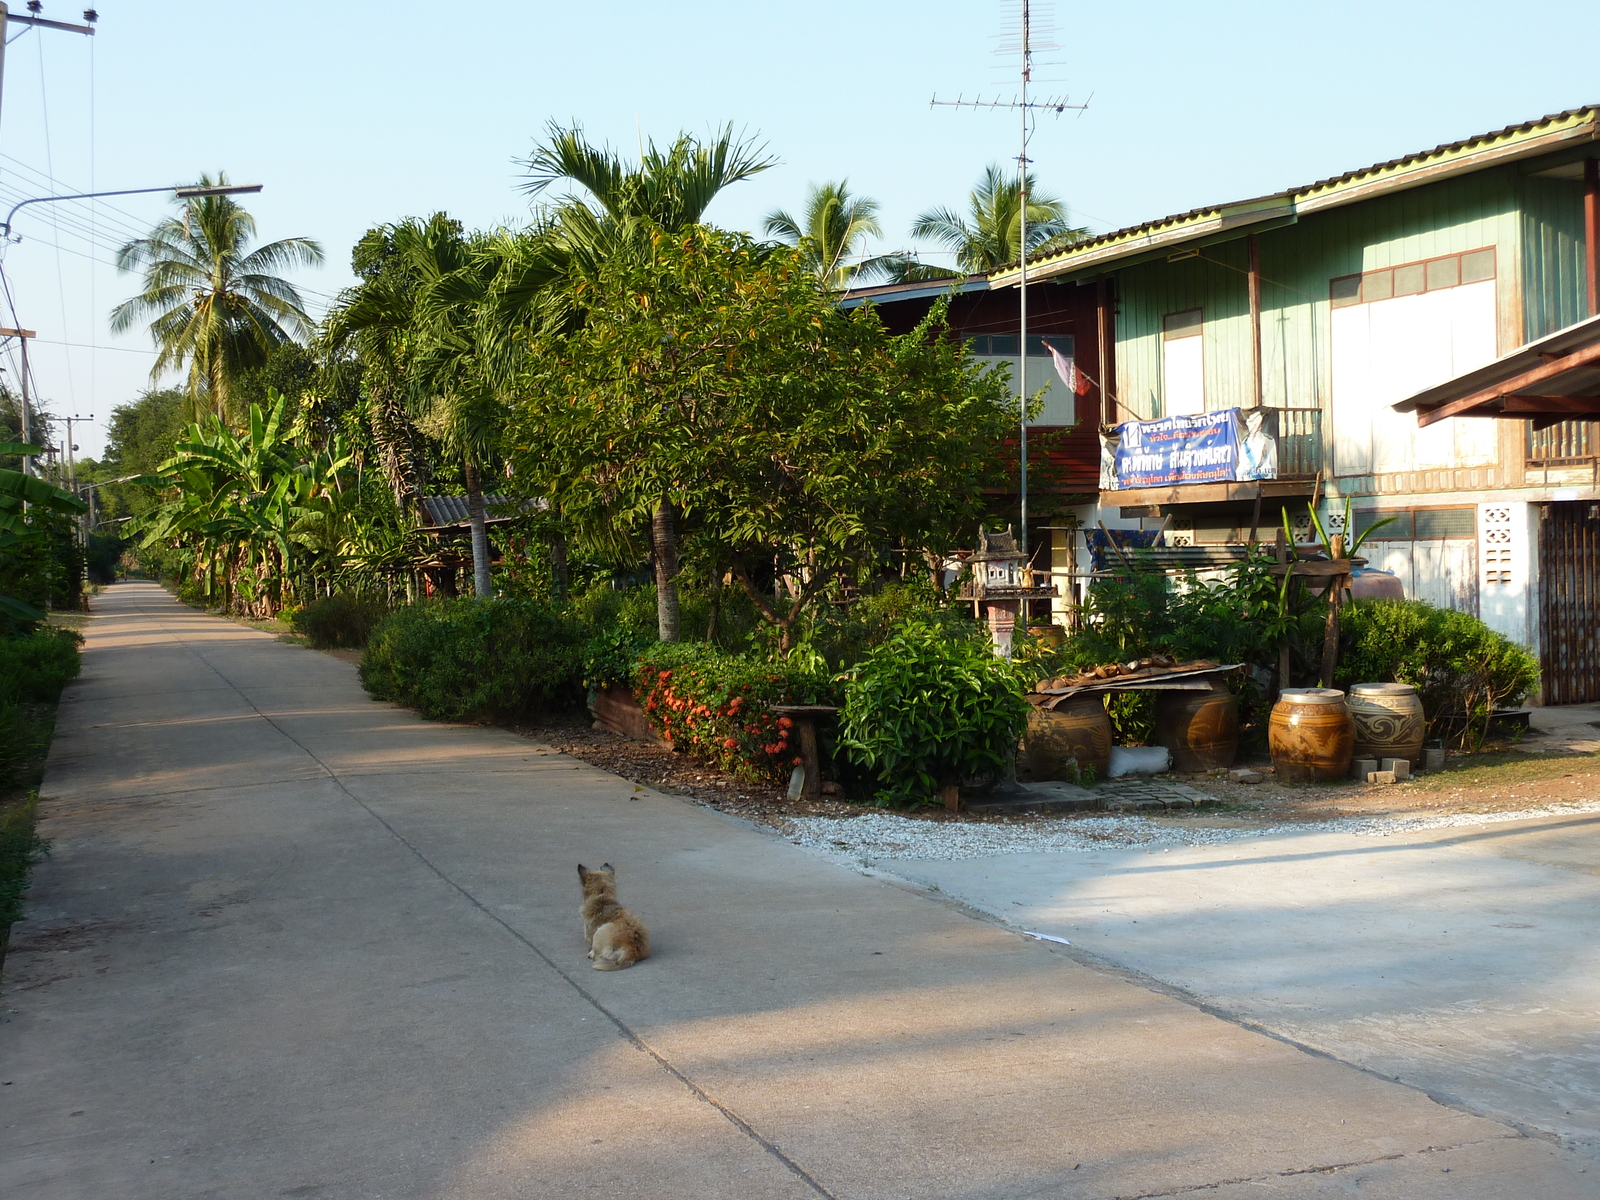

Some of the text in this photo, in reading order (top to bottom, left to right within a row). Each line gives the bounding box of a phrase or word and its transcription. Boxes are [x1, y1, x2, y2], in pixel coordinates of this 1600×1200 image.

[1141, 412, 1229, 434] พรรคไทยรักไทย
